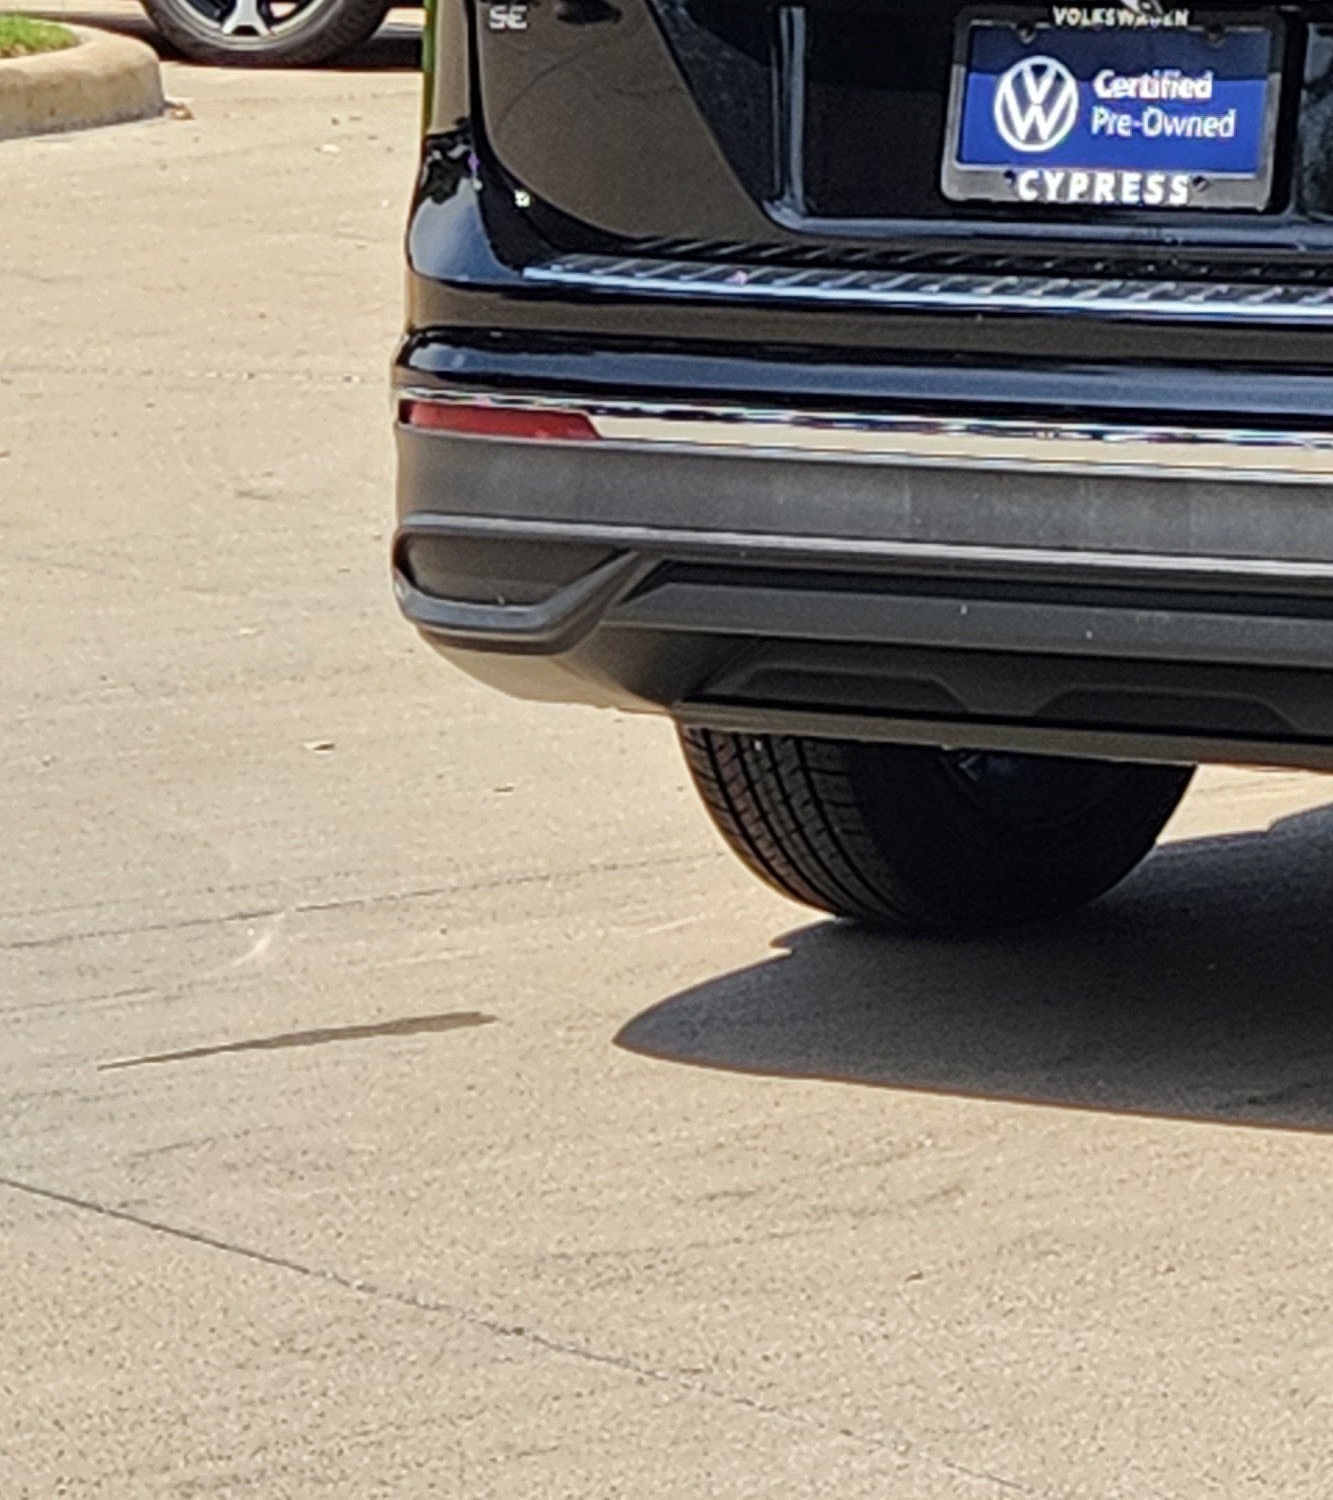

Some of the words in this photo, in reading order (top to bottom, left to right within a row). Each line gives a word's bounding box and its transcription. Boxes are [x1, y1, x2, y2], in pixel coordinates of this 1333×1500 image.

[489, 4, 528, 29] SE
[1094, 69, 1213, 99] Certified
[994, 55, 1079, 152] VW
[1091, 105, 1236, 137] Pre-Owned
[1018, 169, 1189, 205] CYPRESS
